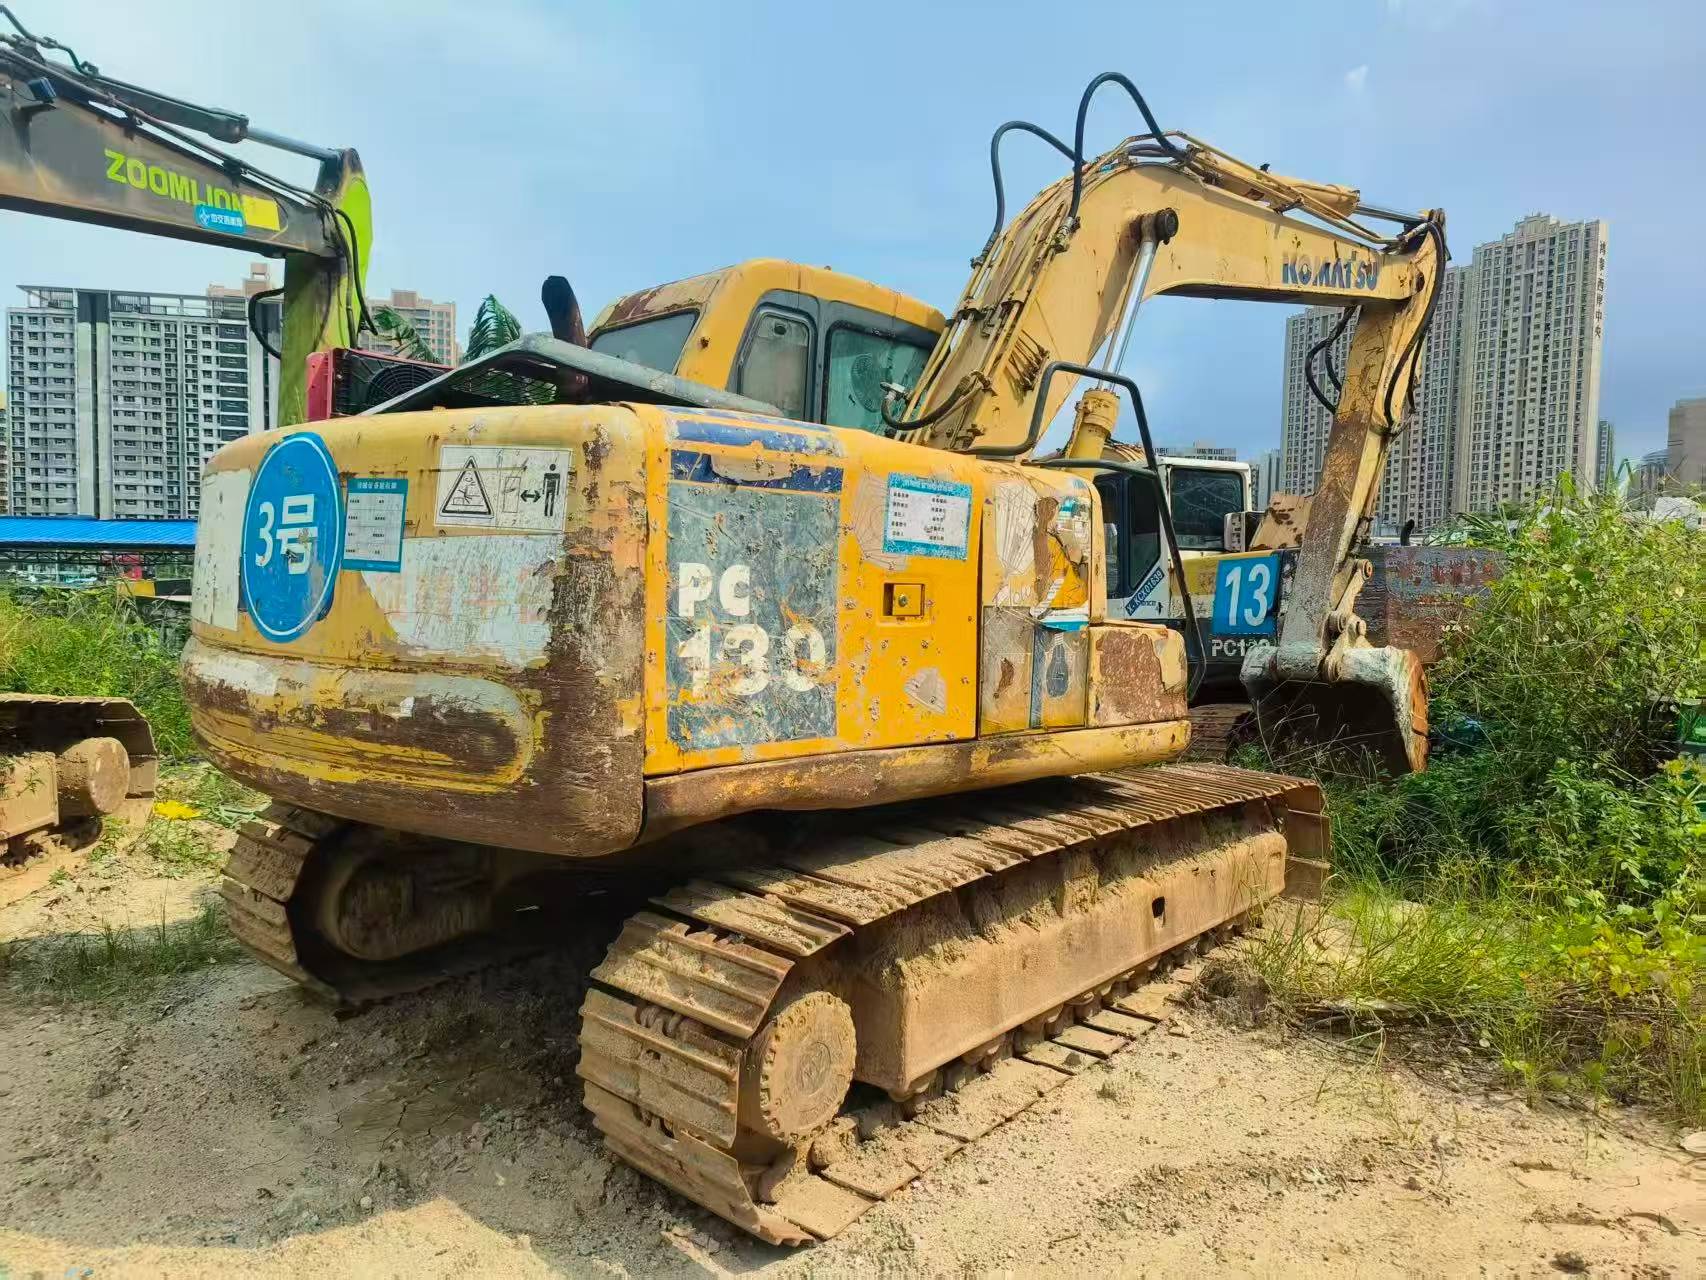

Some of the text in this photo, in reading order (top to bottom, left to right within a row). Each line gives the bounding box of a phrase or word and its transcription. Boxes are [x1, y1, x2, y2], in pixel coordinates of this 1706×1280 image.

[1282, 251, 1378, 291] KOMATSU
[255, 493, 318, 574] 3号
[678, 562, 750, 617] PC
[1224, 563, 1271, 627] 13
[677, 622, 827, 699] 130
